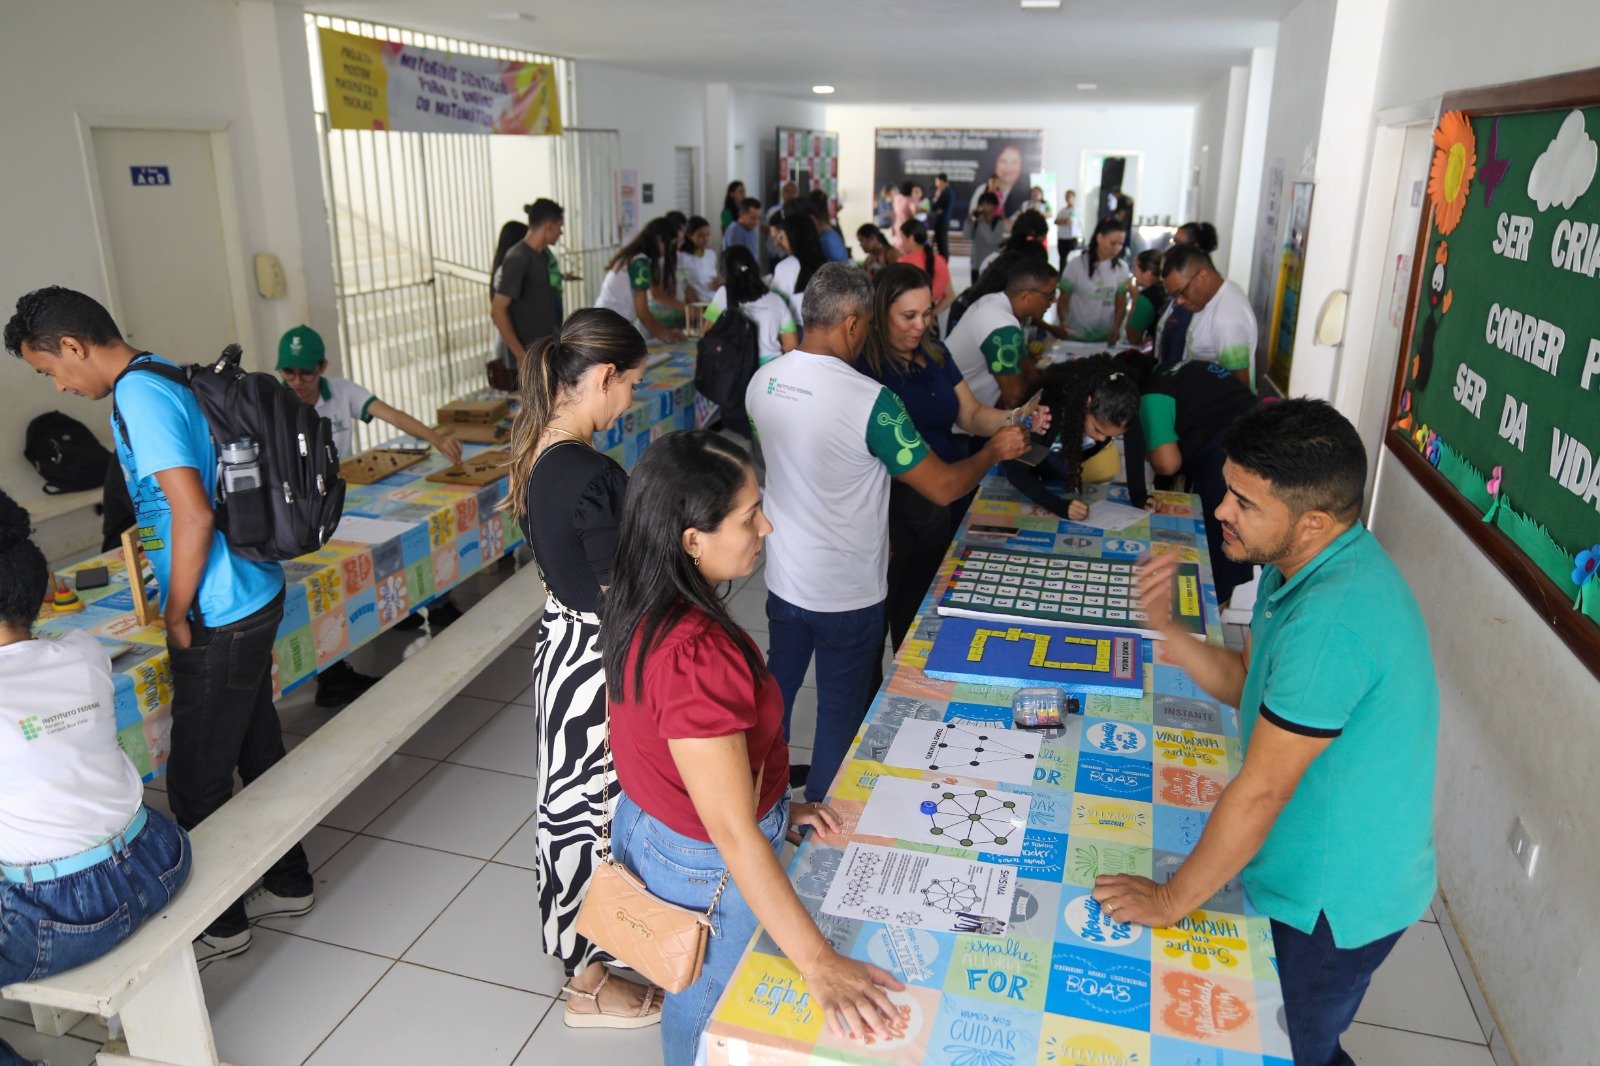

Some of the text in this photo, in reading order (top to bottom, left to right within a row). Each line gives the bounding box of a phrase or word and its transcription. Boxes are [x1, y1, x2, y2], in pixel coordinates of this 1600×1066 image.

[1492, 212, 1534, 262] SER
[1485, 302, 1566, 376] CORRER
[1453, 362, 1487, 420] SER
[1498, 393, 1528, 452] DA
[42, 710, 76, 724] INSTITUTO
[1164, 706, 1215, 721] INSTANTE
[1164, 748, 1212, 764] Sempre
[1033, 768, 1062, 785] OR
[1090, 770, 1138, 786] BOAS
[1030, 798, 1055, 812] DAR
[996, 869, 1010, 896] SHISIMA
[1081, 896, 1102, 946] Acredit
[1111, 920, 1132, 940] Vo
[968, 938, 1033, 962] espalhe
[1190, 935, 1210, 944] em
[890, 927, 919, 977] ULTIVE
[1166, 940, 1230, 964] Sempre
[966, 969, 1028, 1000] FOR
[1066, 974, 1131, 1002] BOAS
[960, 1010, 1012, 1026] VAMOS NOS
[950, 1020, 1016, 1050] CUIDAR
